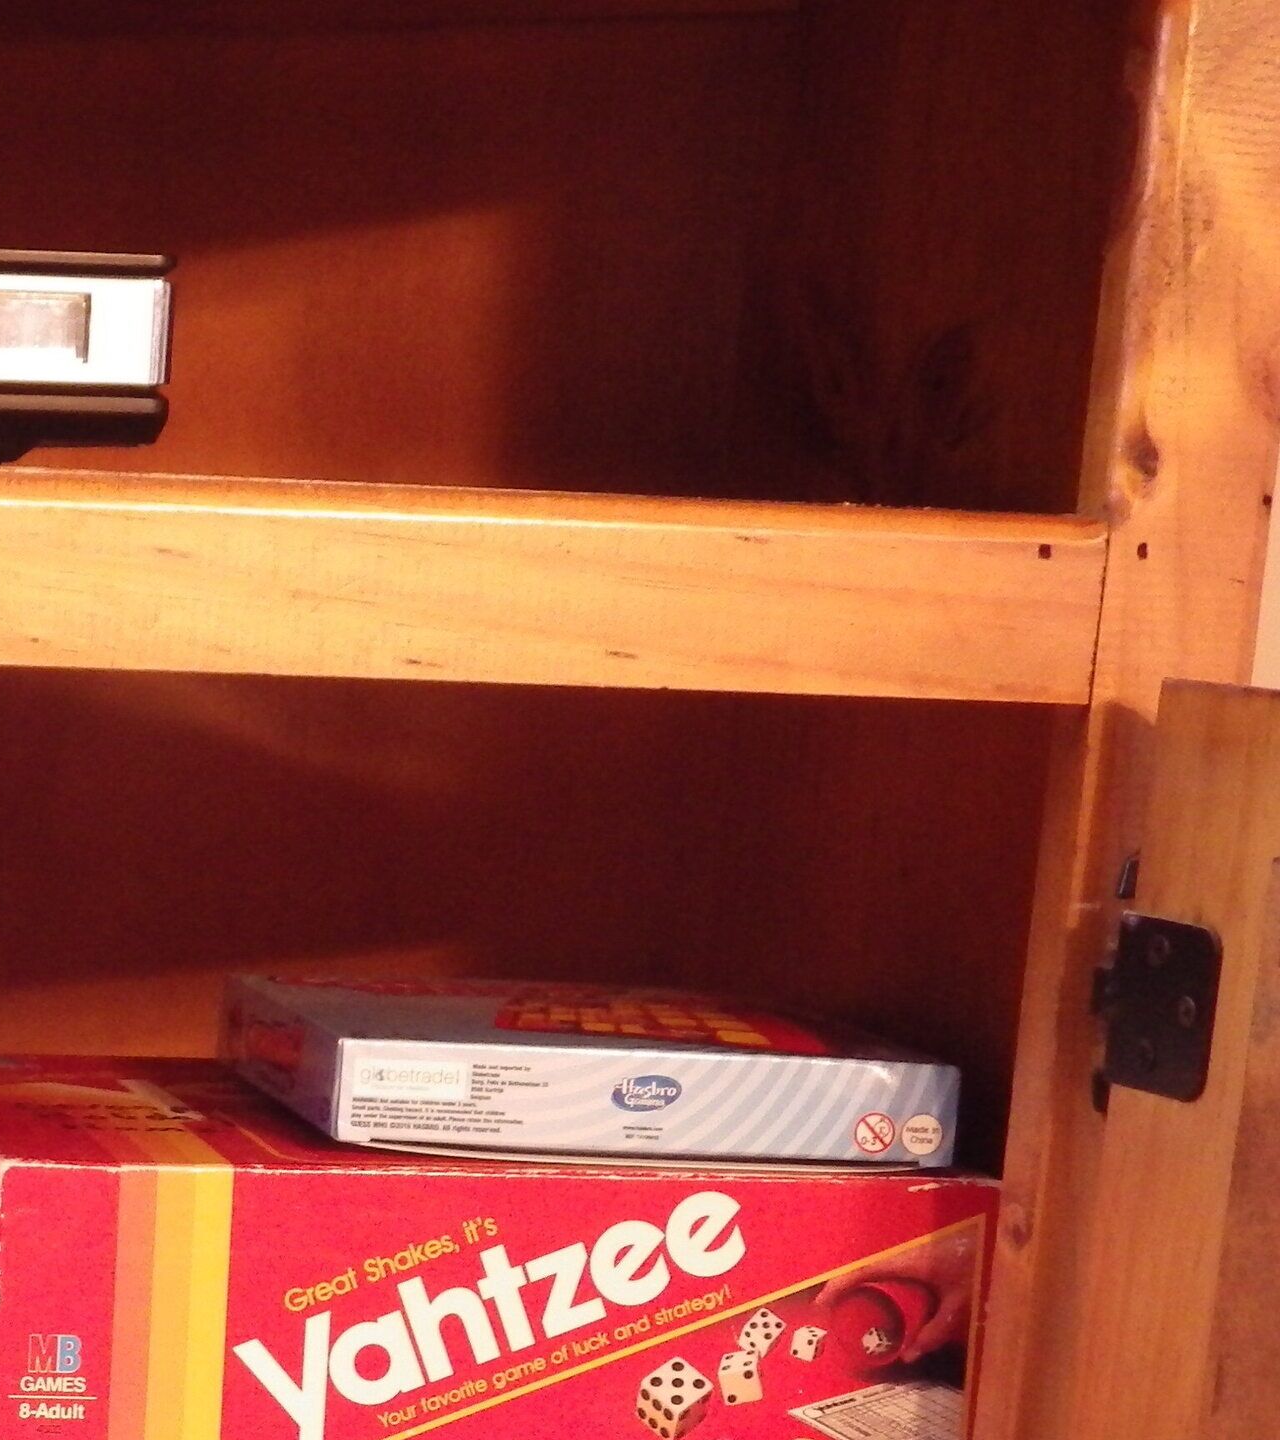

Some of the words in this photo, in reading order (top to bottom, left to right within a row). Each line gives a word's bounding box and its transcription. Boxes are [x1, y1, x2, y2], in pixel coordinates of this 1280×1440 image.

[614, 1077, 678, 1098] Hasbro
[905, 1126, 929, 1135] Made
[910, 1135, 934, 1145] China
[284, 1268, 359, 1313] Great
[364, 1233, 461, 1284] Shakes,
[463, 1215, 499, 1246] it's
[28, 1334, 82, 1373] MB
[377, 1400, 419, 1430] Your
[420, 1376, 489, 1414] favorite
[491, 1353, 547, 1388] game
[550, 1343, 571, 1365] of
[572, 1332, 611, 1357] luck
[613, 1317, 652, 1343] and
[653, 1284, 732, 1327] strategy!
[19, 1376, 87, 1393] GAMES
[18, 1403, 85, 1420] 8-Adult
